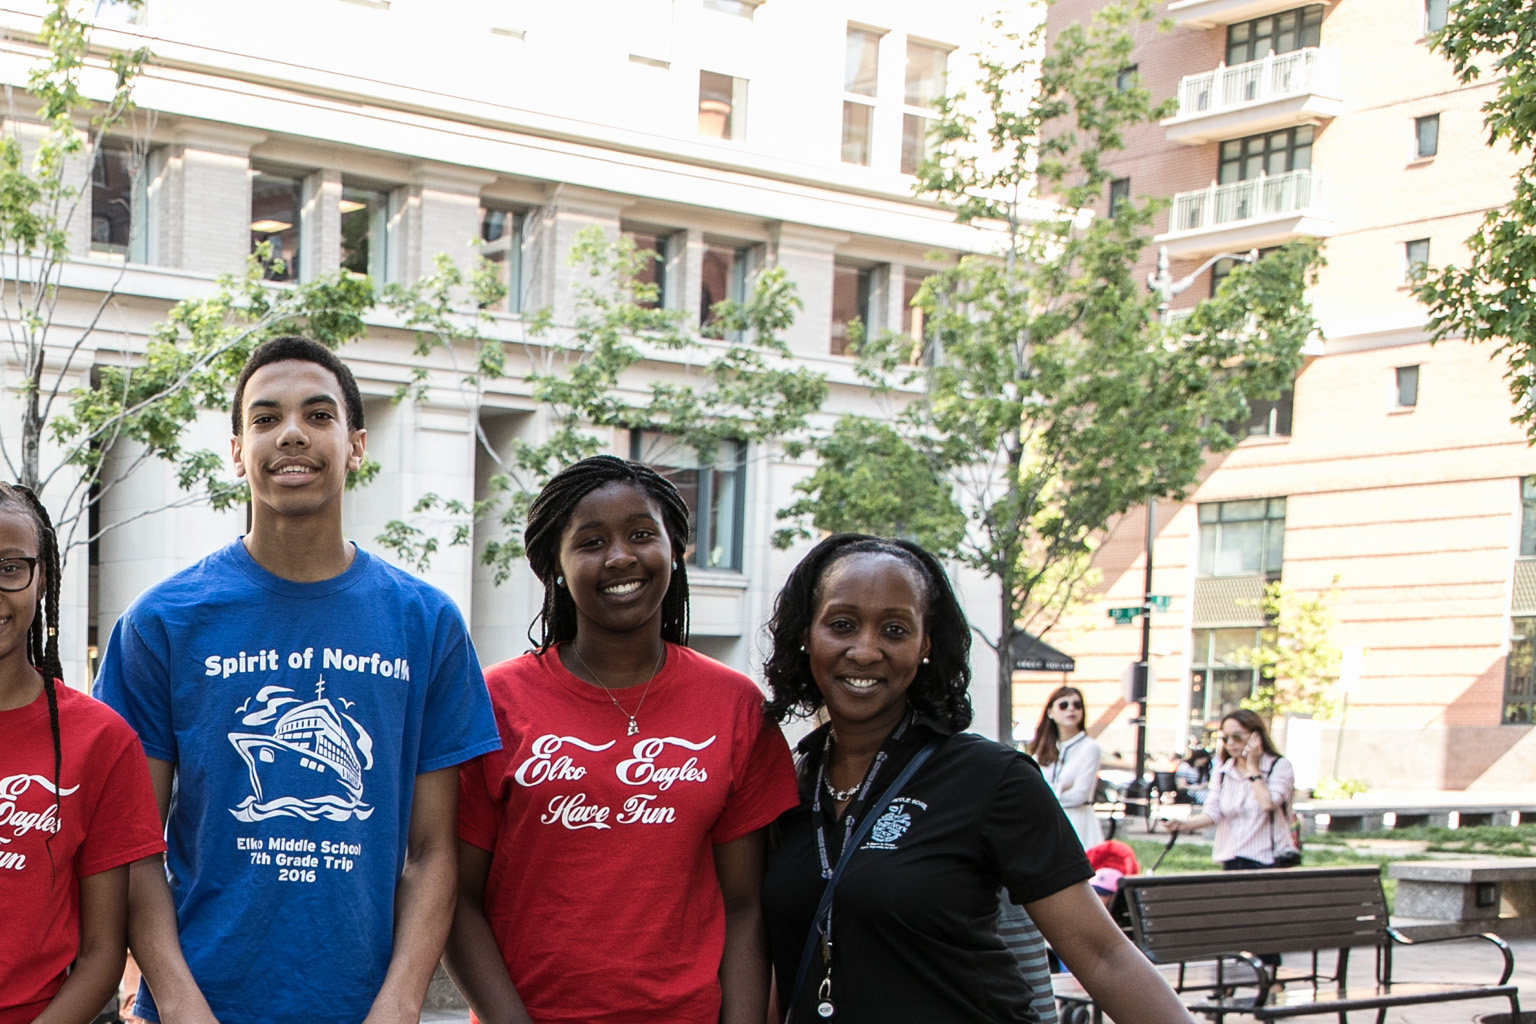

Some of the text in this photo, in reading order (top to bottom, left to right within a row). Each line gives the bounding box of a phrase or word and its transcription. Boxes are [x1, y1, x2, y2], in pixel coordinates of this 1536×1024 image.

[204, 647, 410, 682] Spirit of Norfolk
[514, 734, 716, 791] Elko Eagles
[540, 793, 676, 830] Have Fun
[236, 836, 361, 856] Elko Middle School
[250, 852, 354, 872] 7th Grade Trip
[278, 868, 316, 883] 2016
